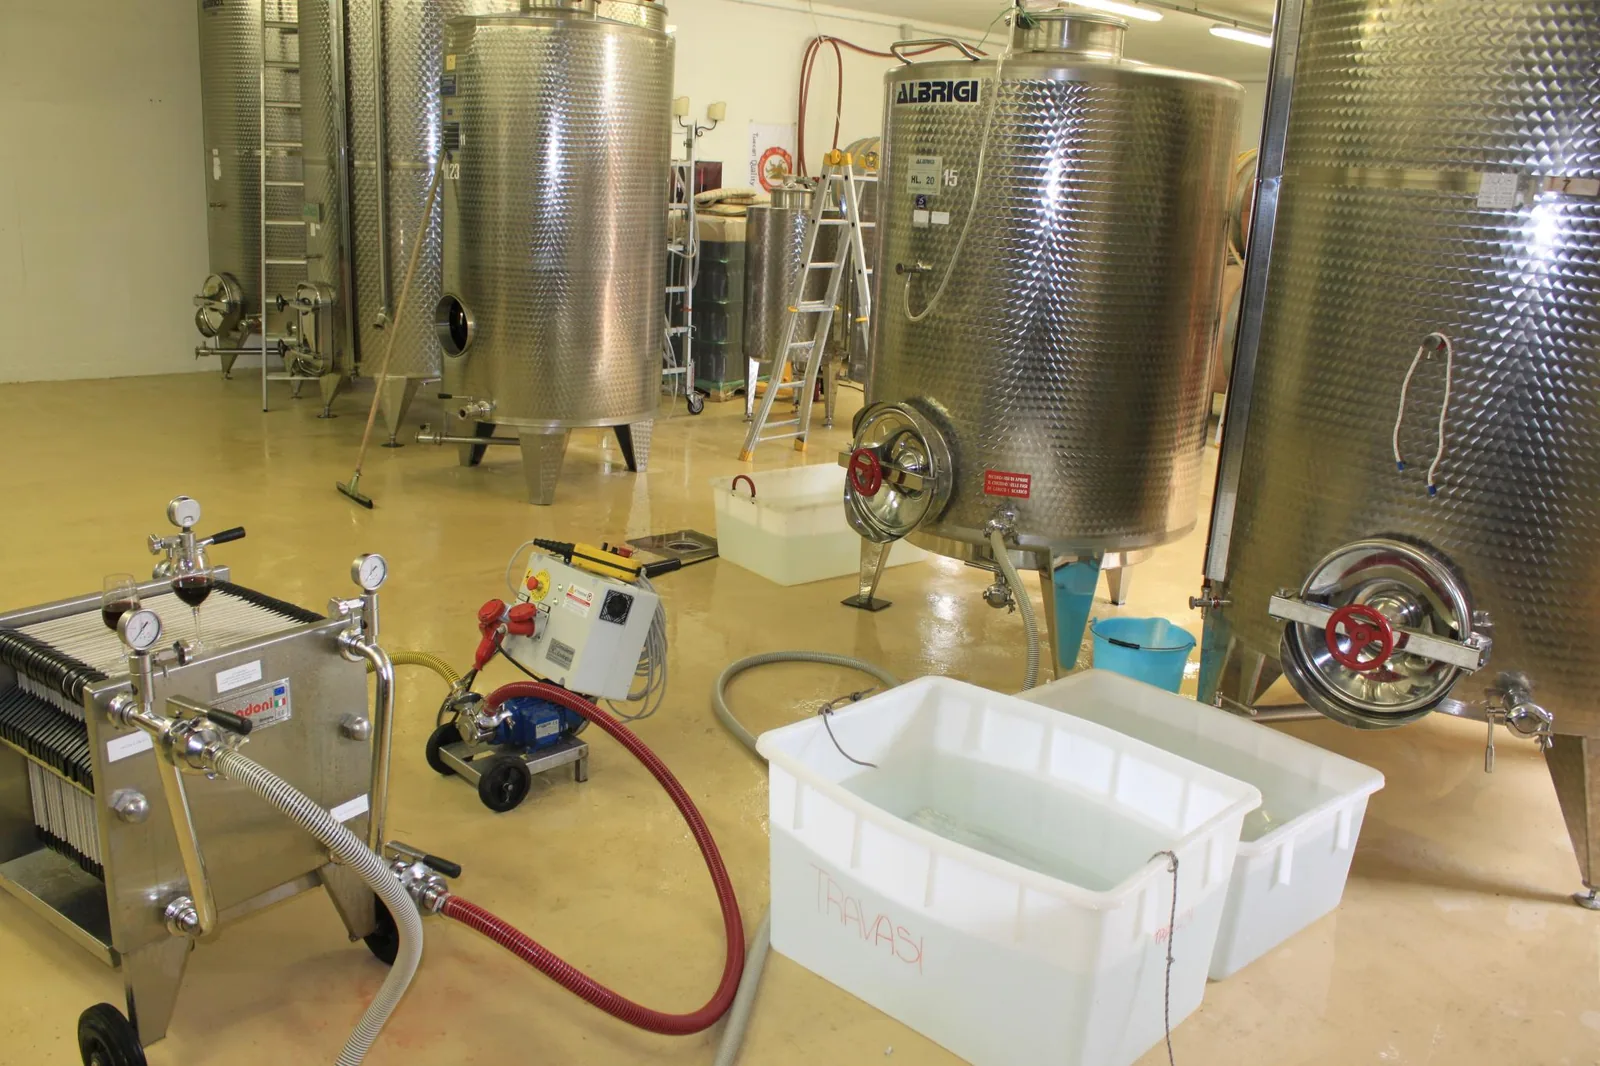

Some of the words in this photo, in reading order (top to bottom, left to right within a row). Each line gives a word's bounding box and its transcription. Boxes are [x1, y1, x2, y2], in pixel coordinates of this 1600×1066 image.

[897, 81, 978, 104] ALBRIGI
[751, 132, 759, 157] Tuscan
[749, 160, 757, 187] Quality
[926, 176, 935, 185] 20
[943, 169, 958, 187] 15
[810, 862, 924, 975] TRAVASI
